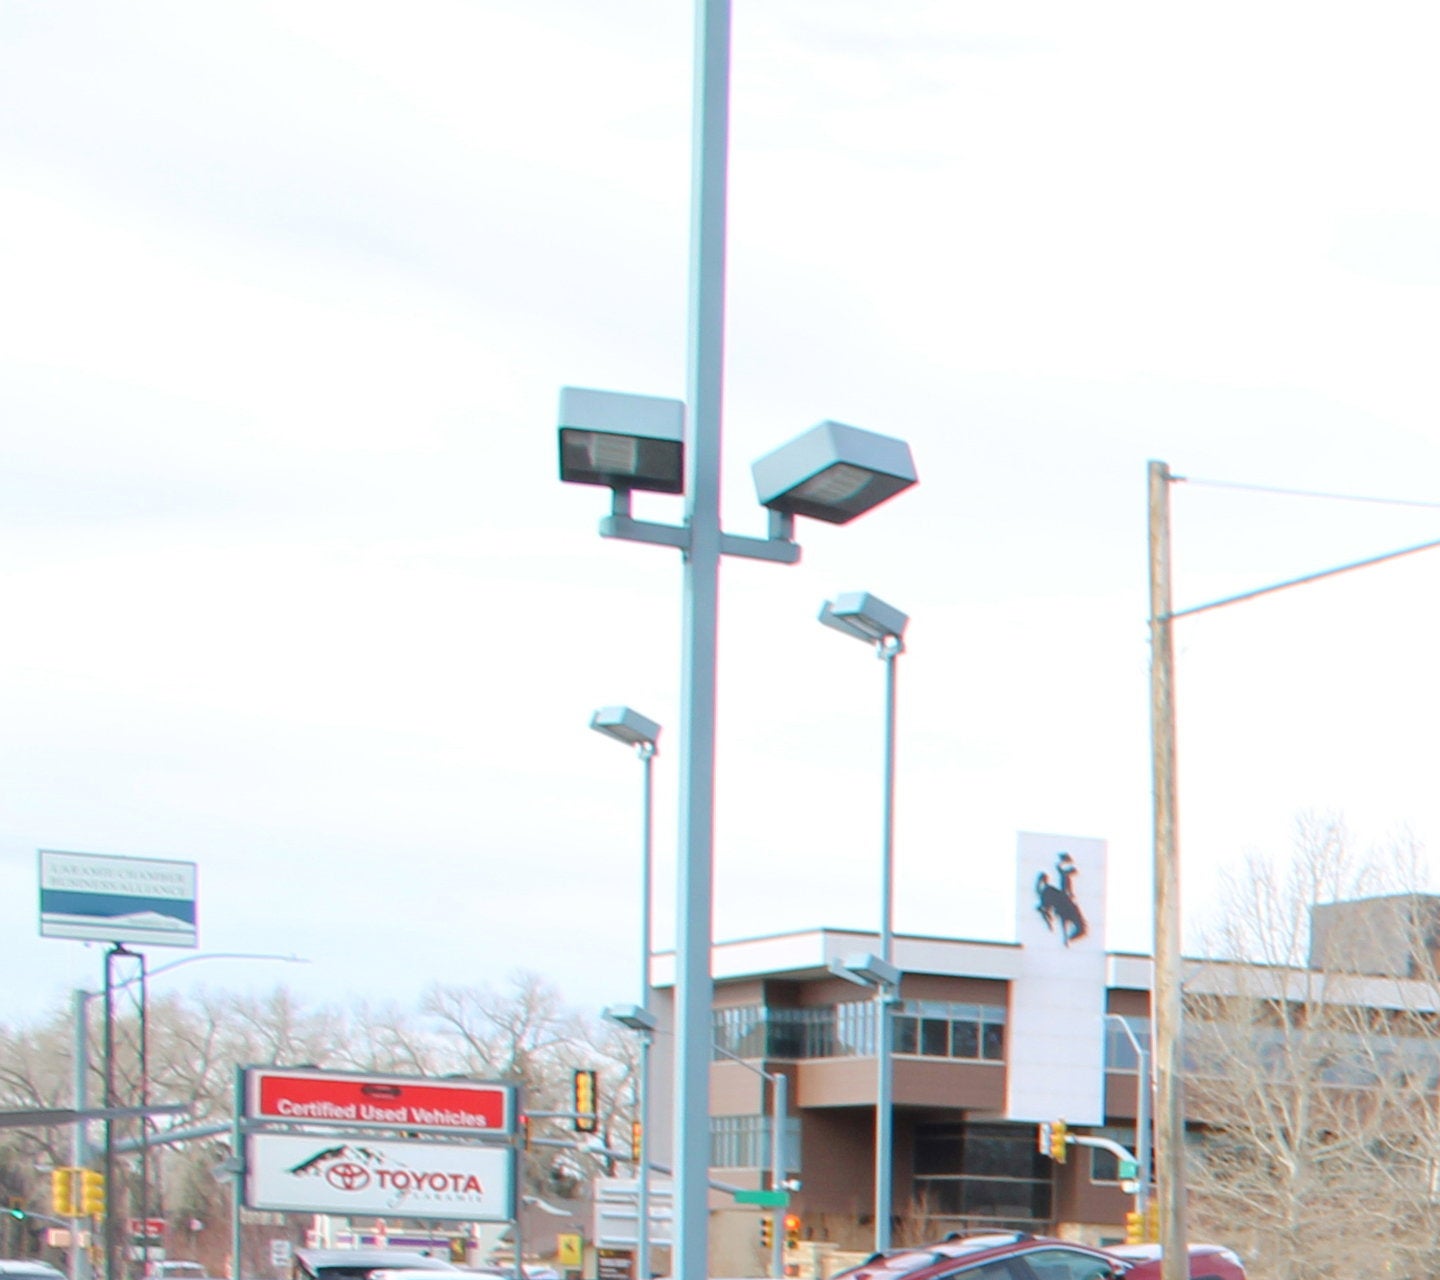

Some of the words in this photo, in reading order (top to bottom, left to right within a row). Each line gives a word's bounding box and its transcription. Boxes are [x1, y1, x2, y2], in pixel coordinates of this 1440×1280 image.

[277, 1098, 356, 1120] Certified
[360, 1103, 407, 1122] Used
[411, 1107, 488, 1128] Vehicles
[376, 1169, 483, 1195] TOYOTA
